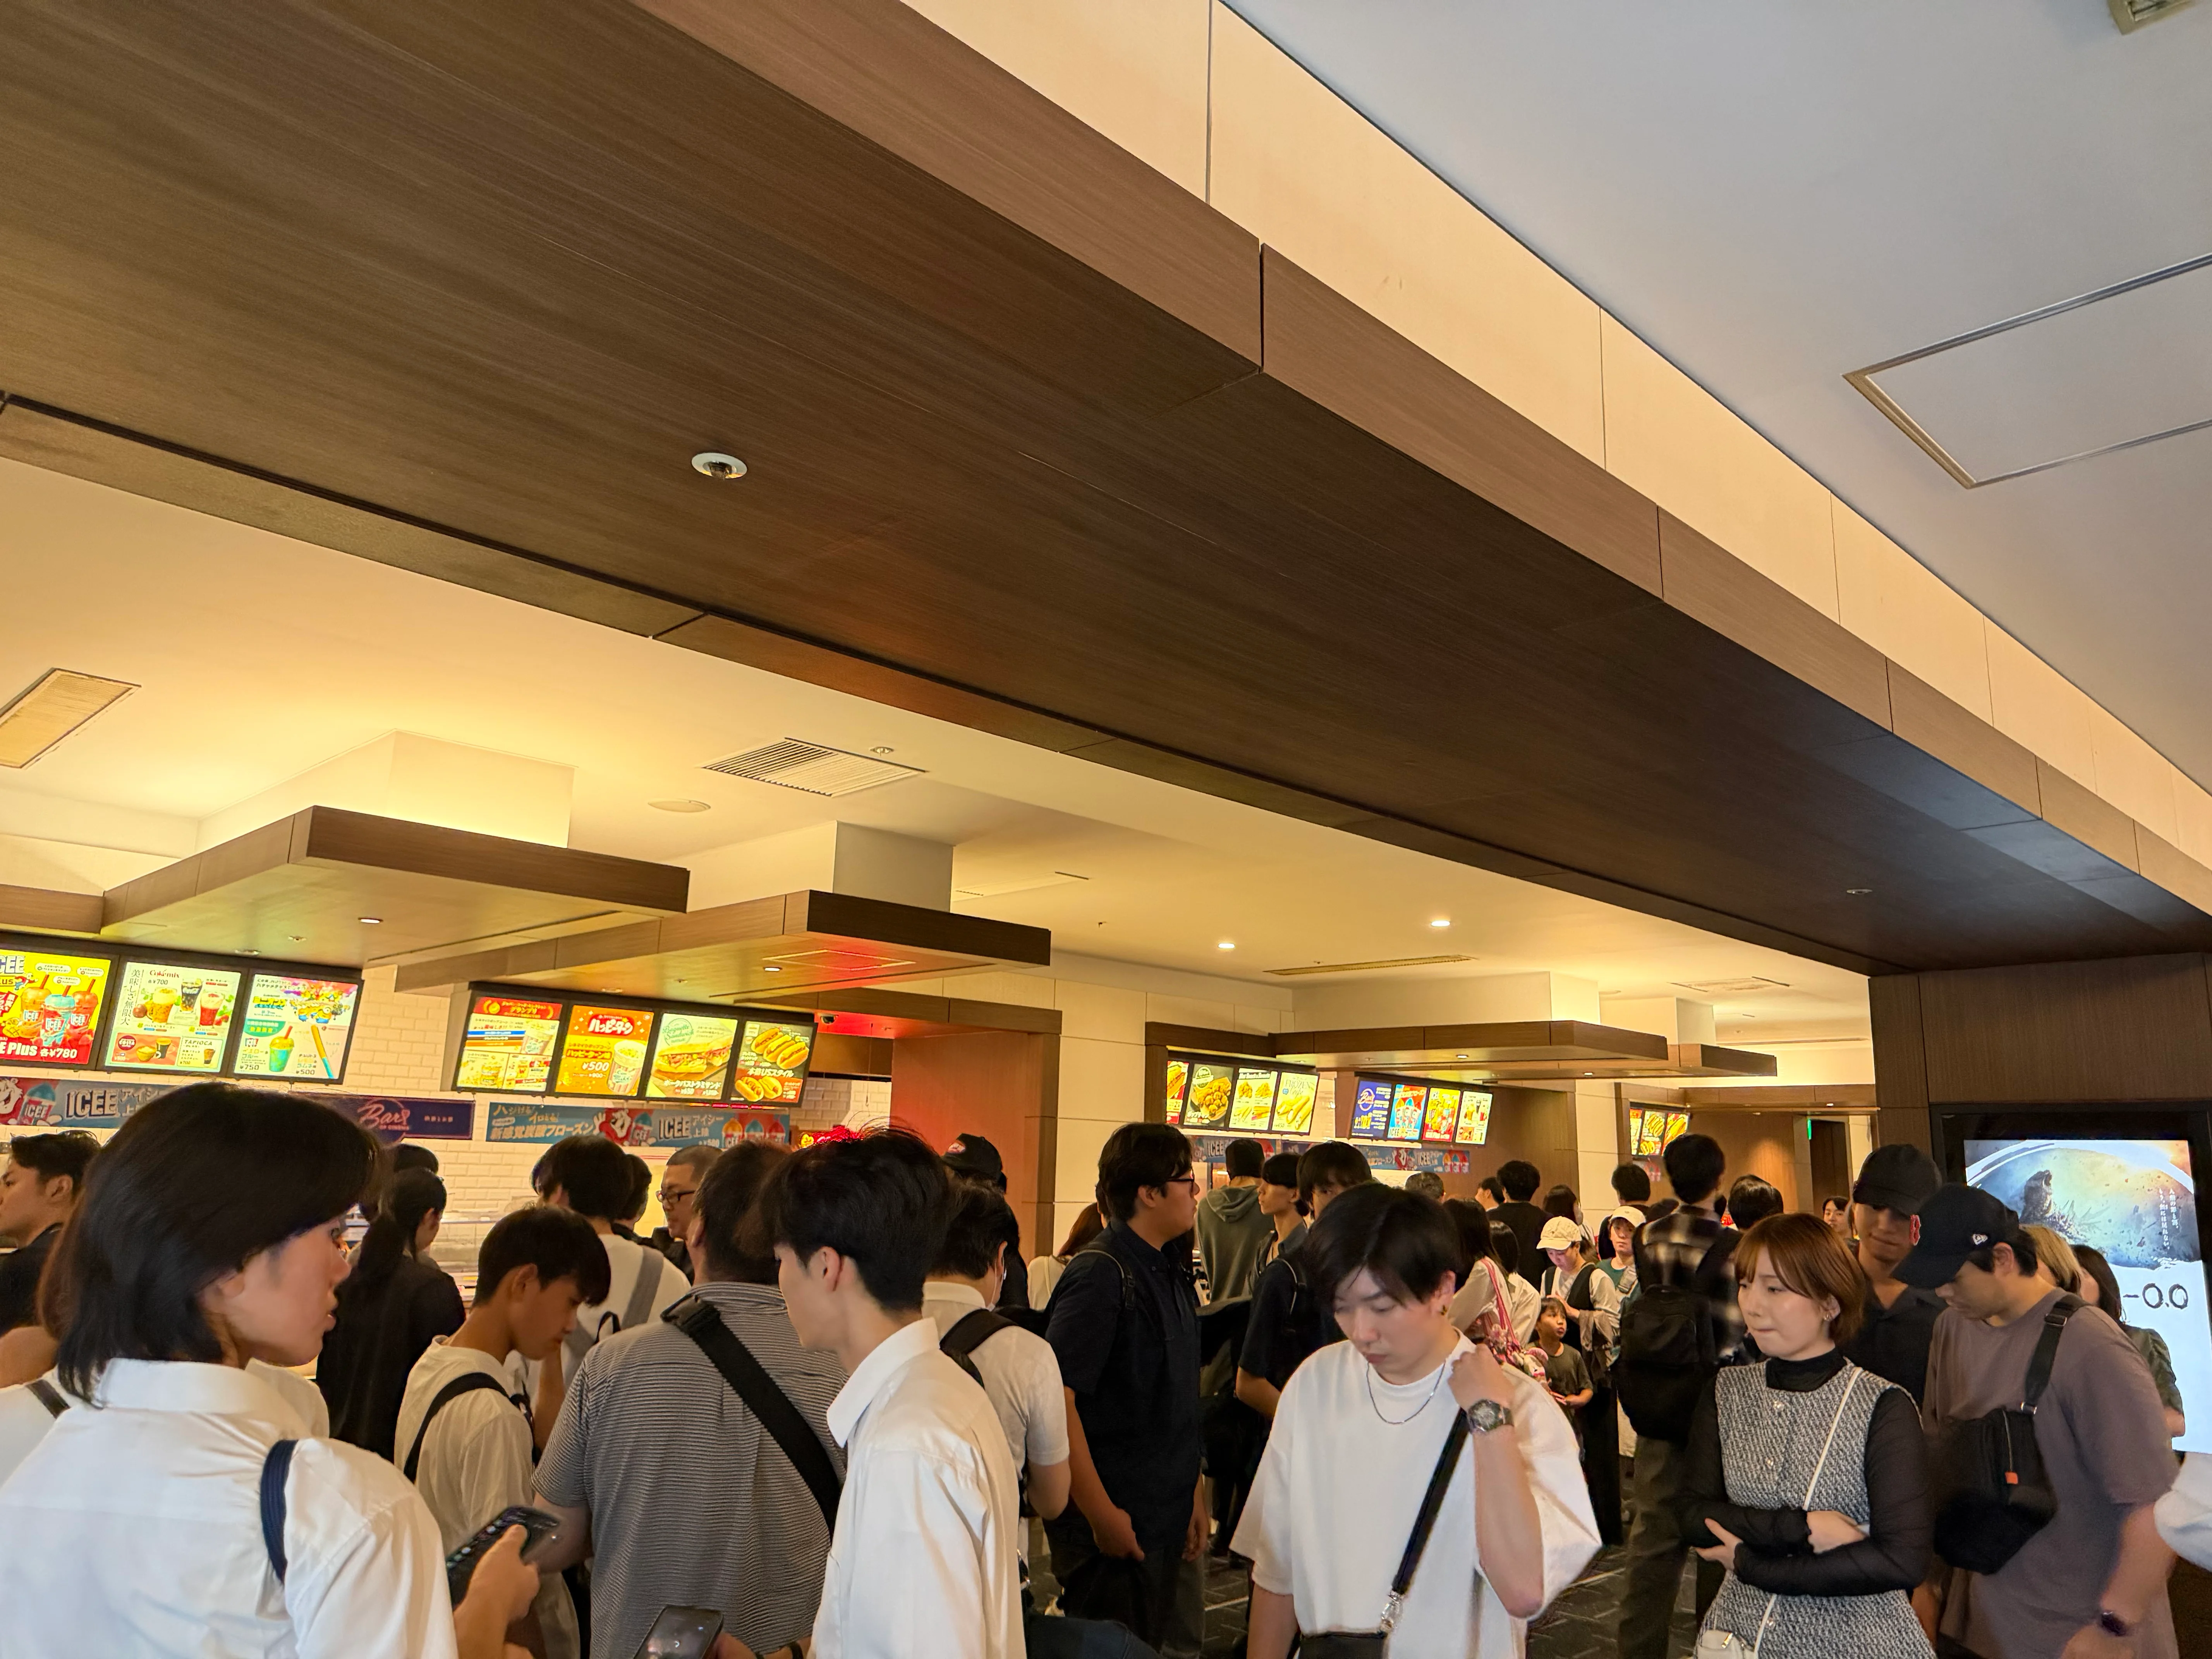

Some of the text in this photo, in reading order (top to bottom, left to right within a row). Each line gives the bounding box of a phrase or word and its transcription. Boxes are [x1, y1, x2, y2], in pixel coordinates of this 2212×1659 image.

[7, 1042, 38, 1056] Plus
[582, 1061, 610, 1072] ¥500
[24, 1104, 48, 1117] ICEE
[66, 1089, 117, 1119] ICEE
[659, 1116, 691, 1139] ICEE
[1207, 1142, 1224, 1158] ICEE
